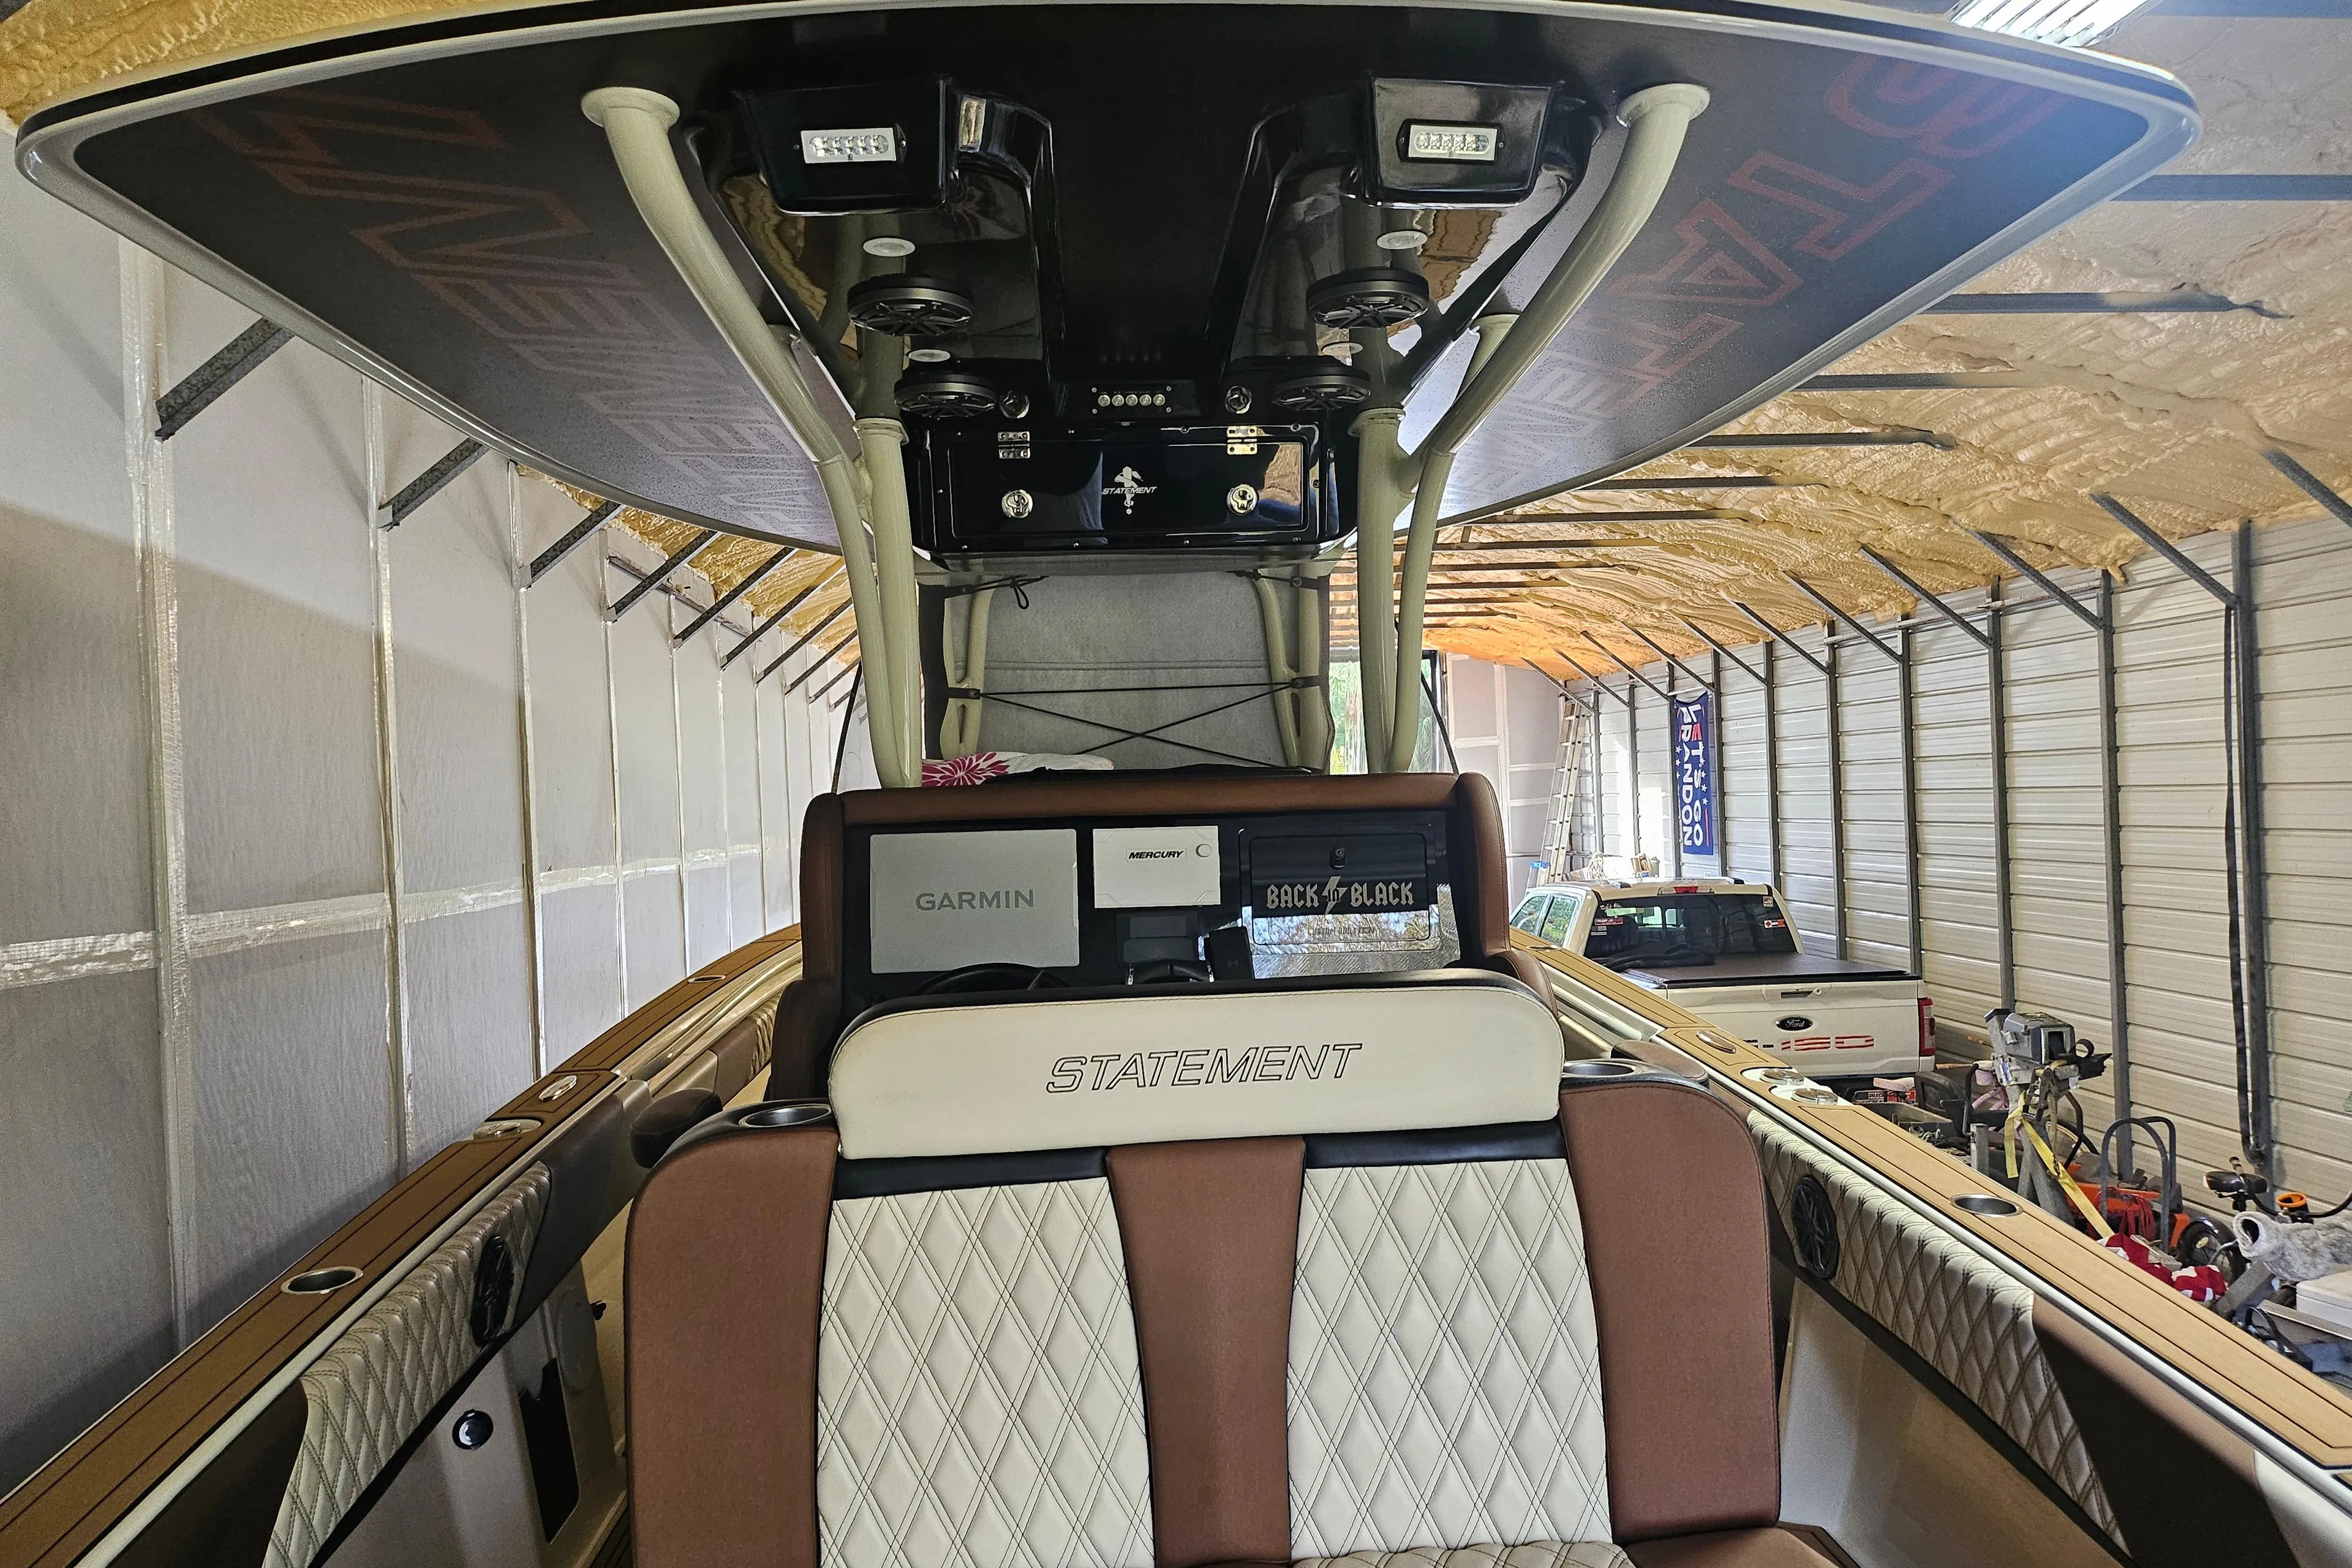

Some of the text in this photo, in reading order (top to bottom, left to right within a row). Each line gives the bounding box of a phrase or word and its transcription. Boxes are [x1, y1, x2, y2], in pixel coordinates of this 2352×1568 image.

[1101, 486, 1157, 495] STATEMENT
[1680, 706, 1694, 846] BRANDON
[1693, 799, 1703, 846] GO
[1128, 850, 1185, 860] MERCURY
[915, 889, 1035, 911] GARMIN
[1266, 884, 1319, 910] BACK
[1350, 881, 1415, 908] BLACK
[1785, 1019, 1806, 1028] Ford
[1046, 1042, 1363, 1094] STATEMENT
